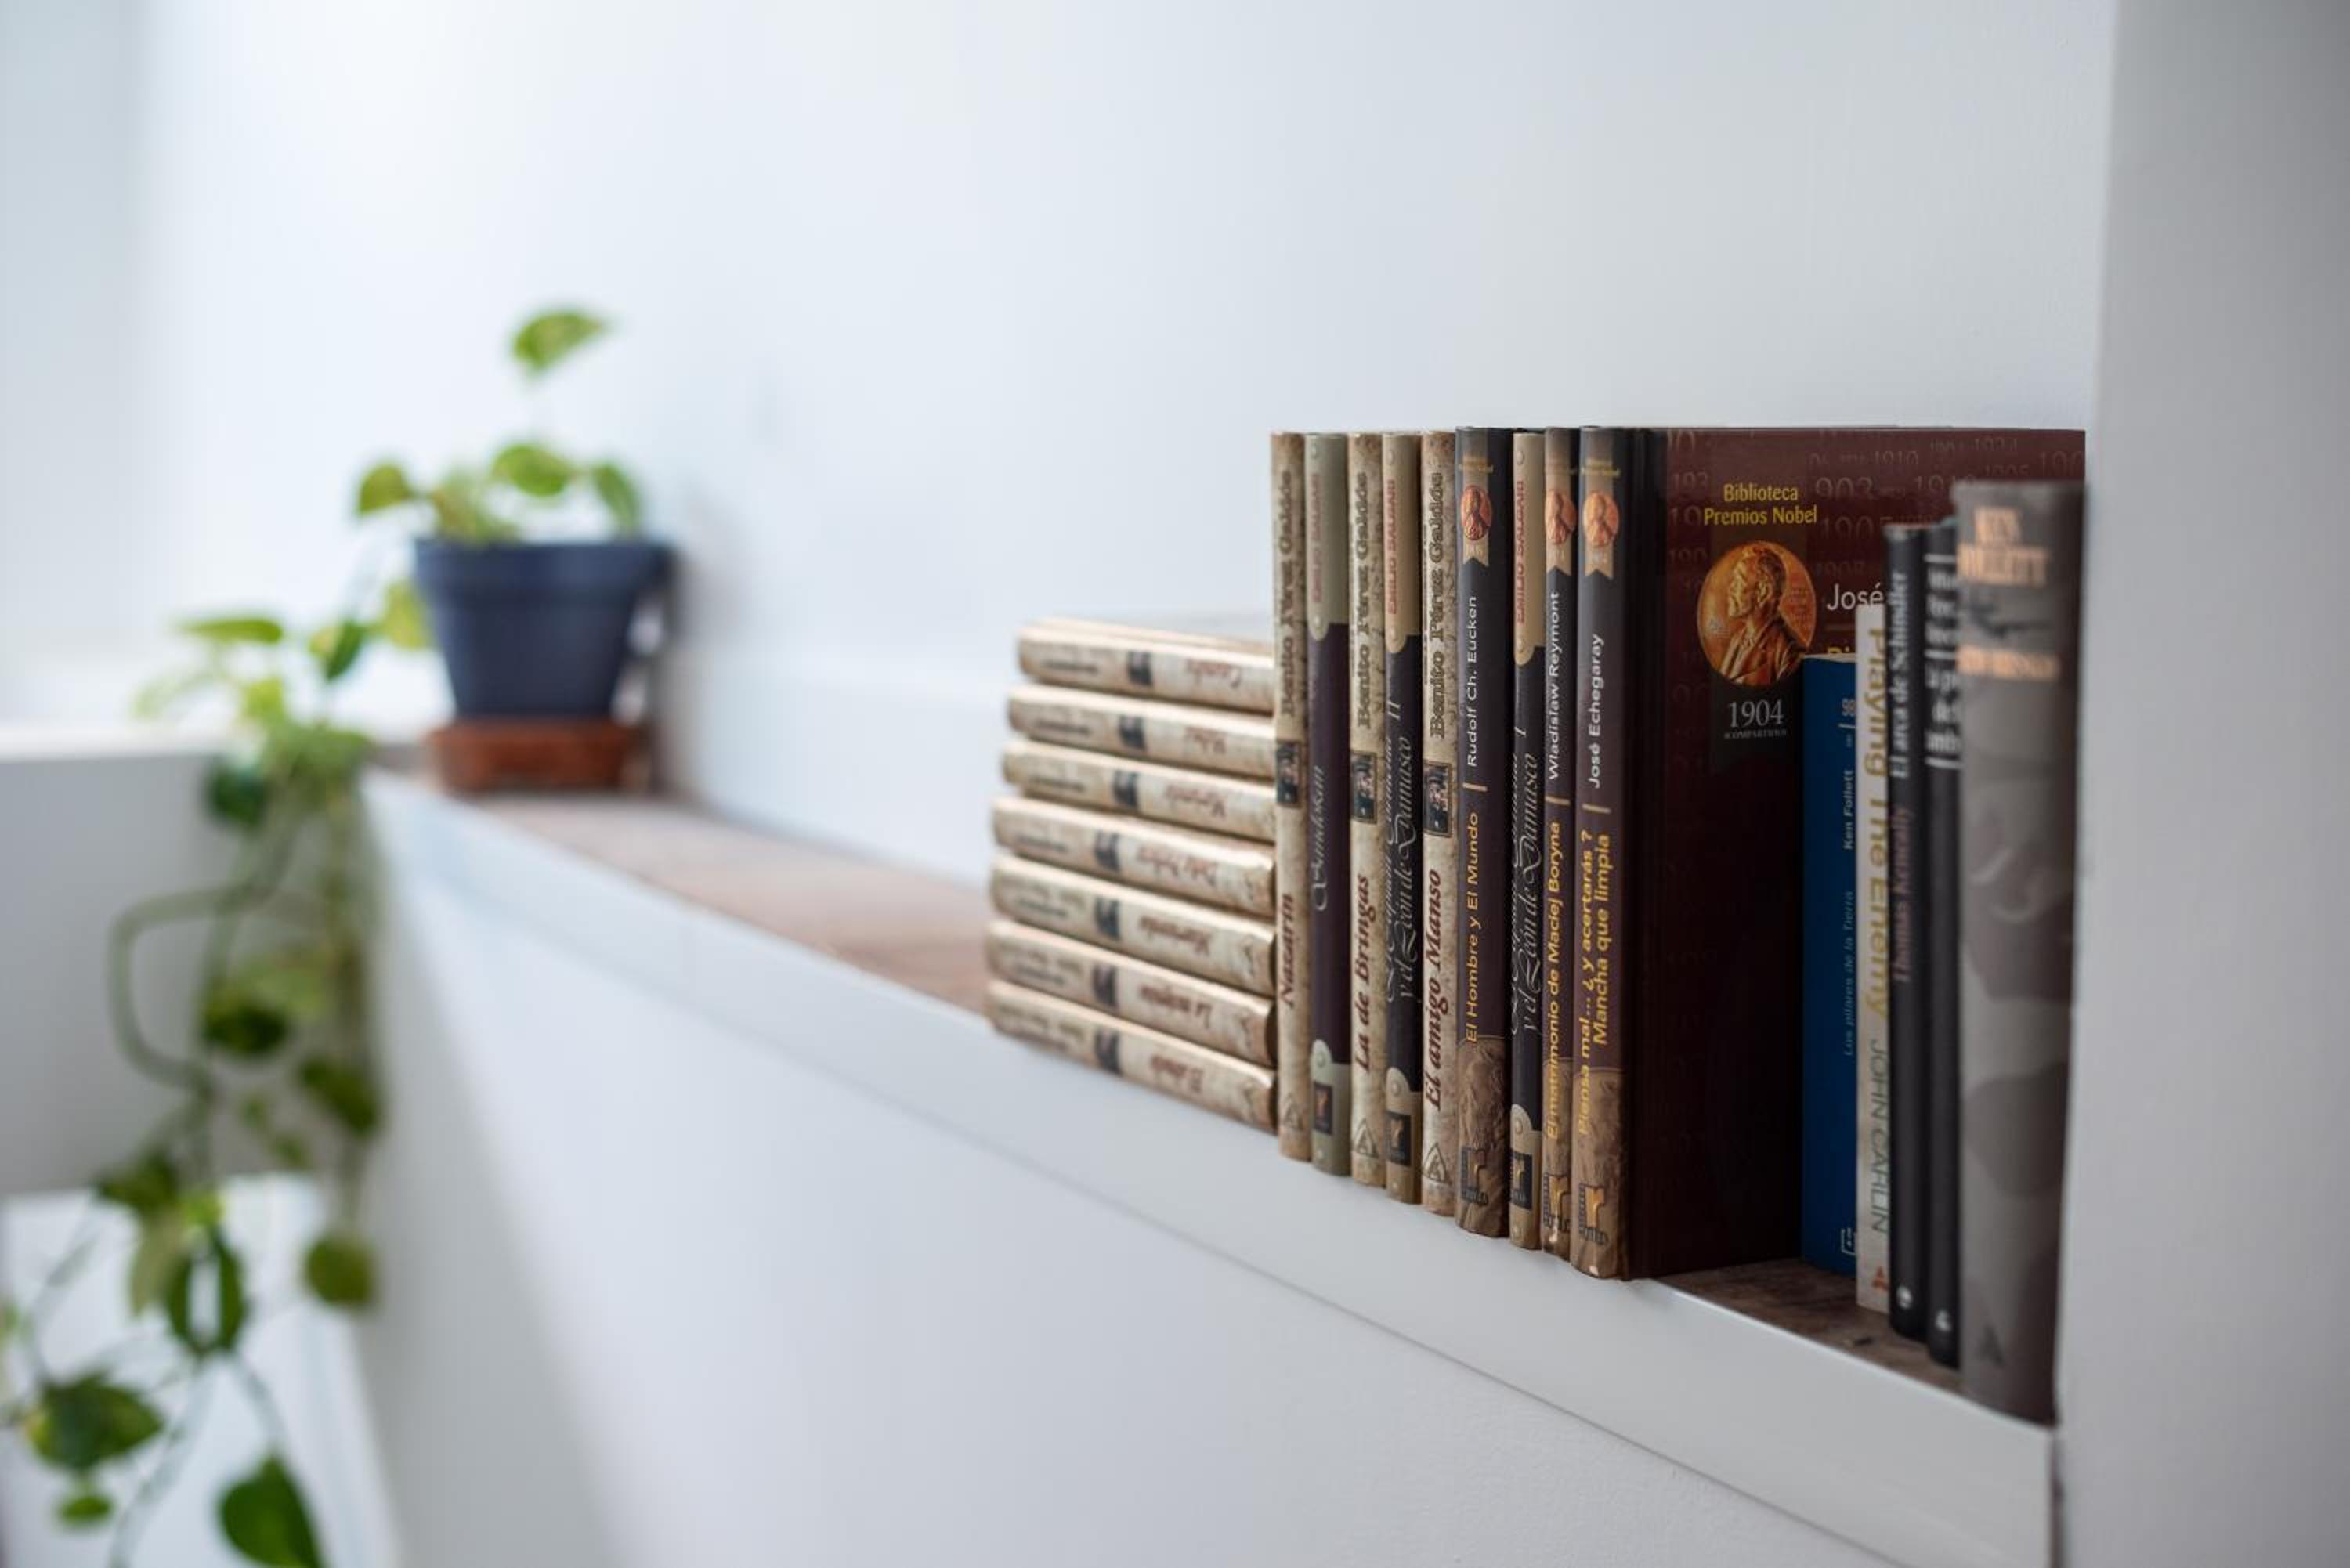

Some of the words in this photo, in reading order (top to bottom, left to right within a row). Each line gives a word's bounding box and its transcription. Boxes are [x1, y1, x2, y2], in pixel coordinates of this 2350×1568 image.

[1355, 472, 1369, 559] Galdós
[1387, 478, 1397, 551] SALGARI
[1430, 471, 1444, 563] Galdós
[1516, 480, 1524, 555] SALGARI
[1704, 508, 1768, 526] Premios
[1772, 504, 1818, 525] Nobel
[1723, 482, 1799, 503] Biblioteca
[1357, 565, 1369, 635] Pérez
[1387, 556, 1397, 614] EMILIO
[1430, 568, 1444, 641] Pérez
[1516, 564, 1524, 625] EMILIO
[1826, 581, 1884, 612] José
[1466, 595, 1477, 663] Eucken
[1549, 591, 1563, 677] Reymont
[1889, 572, 1910, 670] Schindler
[1358, 645, 1371, 729] Benito
[1430, 651, 1445, 739] Benito
[1466, 670, 1477, 701] Ch.
[1589, 633, 1604, 737] Echegaray
[1728, 699, 1786, 728] 1904
[1864, 628, 1885, 776] Playing
[1889, 675, 1908, 703] de
[1466, 708, 1477, 767] Rudolf
[1549, 683, 1560, 780] Wladislaw
[1891, 708, 1909, 752] arca
[1393, 736, 1417, 860] Damasco
[1589, 742, 1600, 789] José
[1842, 768, 1853, 817] Follett
[1890, 756, 1909, 779] El
[1310, 765, 1327, 911] Sandokan
[1467, 812, 1479, 885] Mundo
[1519, 753, 1542, 885] Damasco
[1581, 829, 1593, 841] ?
[1842, 818, 1853, 851] Ken
[1869, 799, 1887, 867] The
[1548, 821, 1563, 893] Boryna
[1594, 834, 1613, 902] limpia
[1354, 873, 1376, 985] Bringas
[1425, 869, 1441, 972] Manso
[1467, 891, 1478, 909] El
[1470, 916, 1481, 930] y
[1548, 898, 1563, 963] Maciej
[1582, 851, 1593, 952] acertarás
[1595, 908, 1612, 952] que
[1843, 891, 1854, 933] Tierra
[1466, 934, 1478, 1017] Hombre
[1548, 969, 1559, 995] de
[1582, 956, 1595, 973] y
[1844, 953, 1854, 974] de
[1865, 876, 1889, 1021] Enemy
[1354, 991, 1369, 1026] de
[1425, 977, 1448, 1070] amigo
[1466, 1023, 1477, 1042] El
[1593, 958, 1609, 1045] Mancha
[1355, 1034, 1370, 1073] La
[1548, 1001, 1559, 1117] matrimonio
[1870, 1039, 1889, 1121] JOHN
[1424, 1074, 1441, 1111] El
[1578, 1064, 1590, 1135] Piensa
[1547, 1118, 1558, 1141] El
